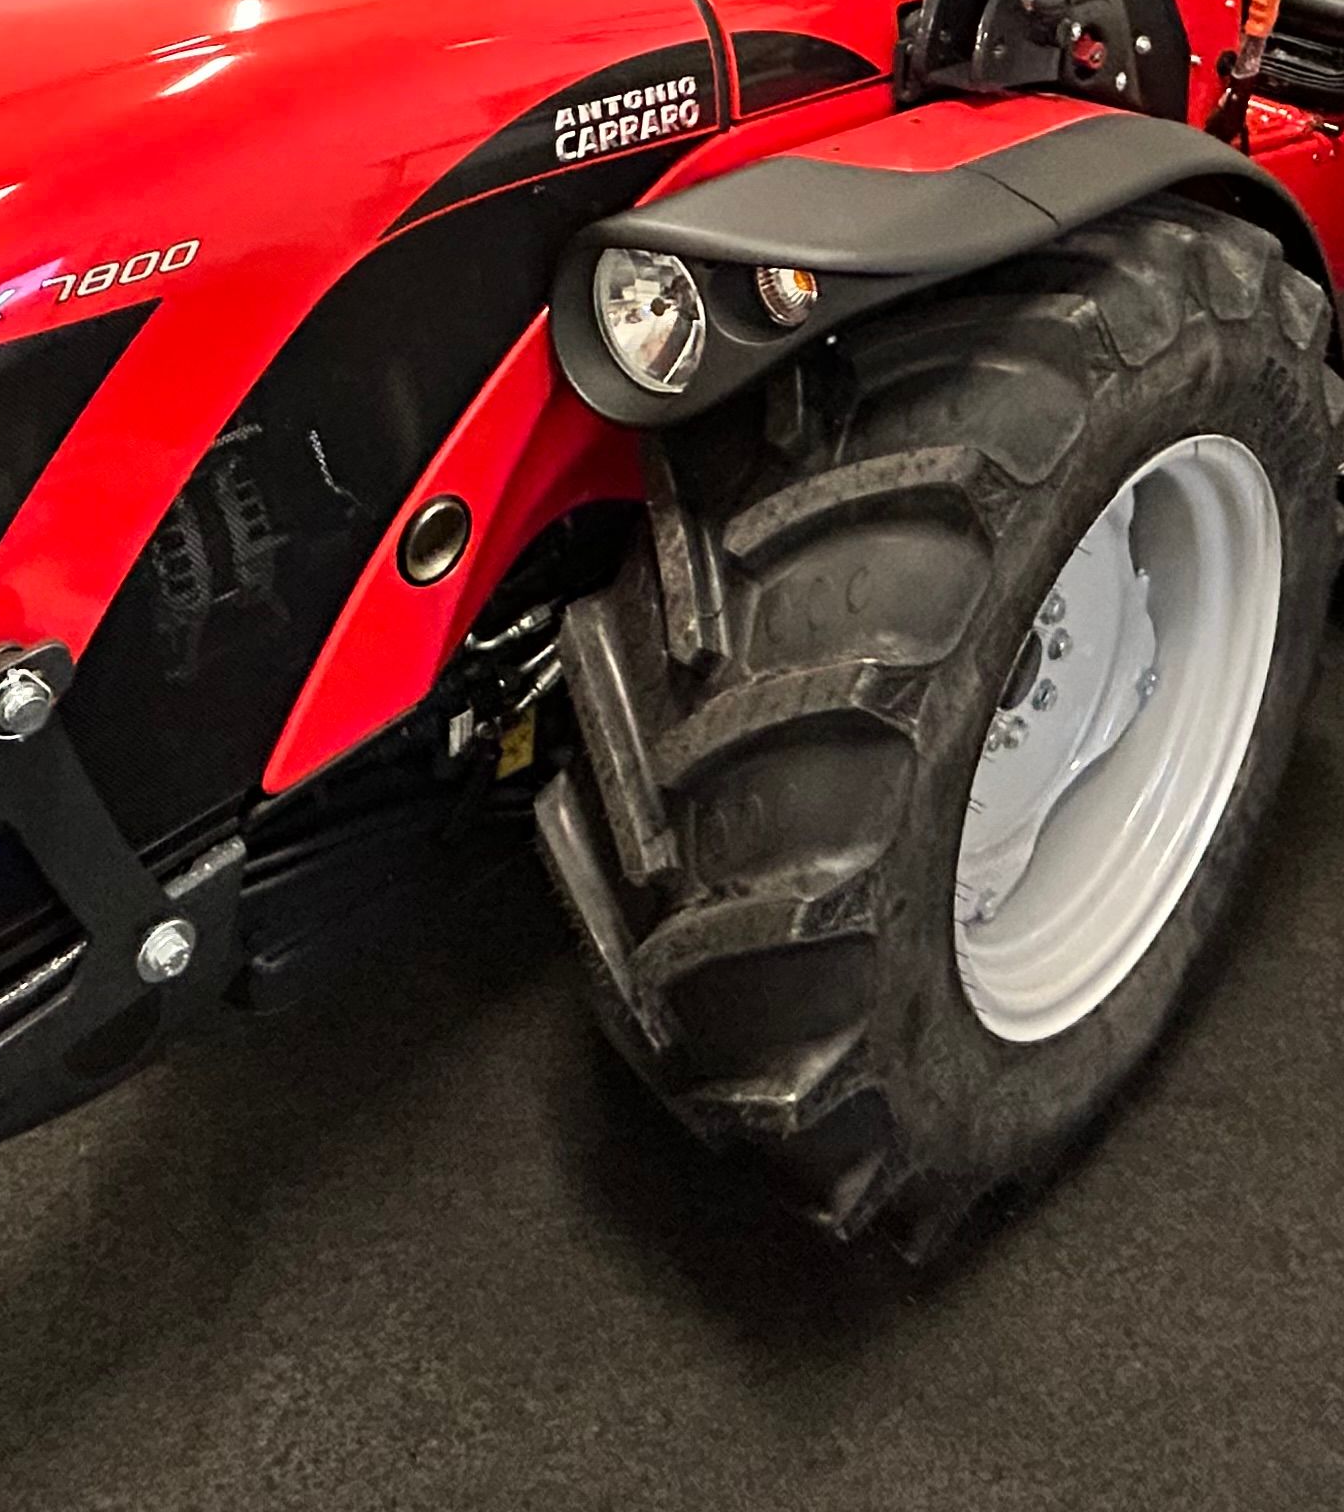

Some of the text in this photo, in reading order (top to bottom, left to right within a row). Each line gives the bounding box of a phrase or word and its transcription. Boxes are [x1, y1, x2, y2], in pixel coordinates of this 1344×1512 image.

[554, 76, 697, 131] ANTONIO
[555, 99, 700, 162] CARRARO
[41, 238, 201, 303] 7800
